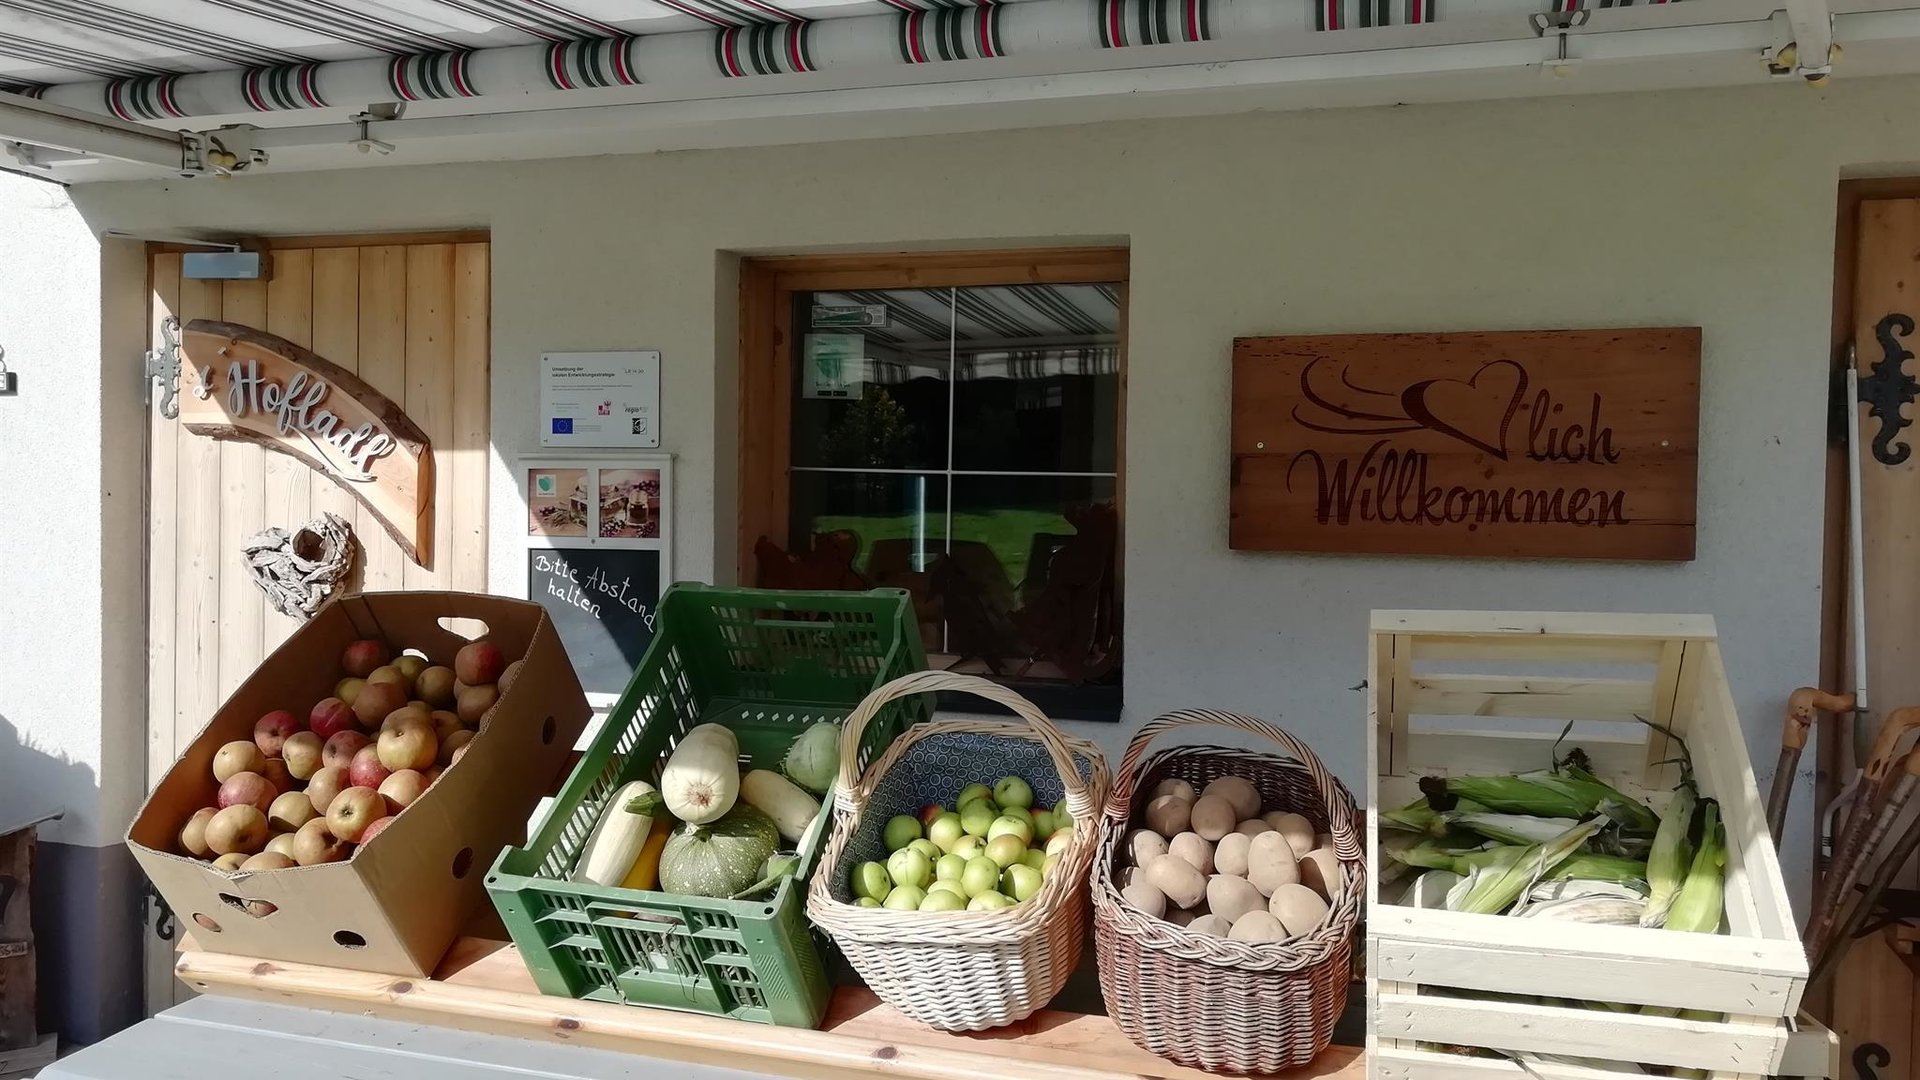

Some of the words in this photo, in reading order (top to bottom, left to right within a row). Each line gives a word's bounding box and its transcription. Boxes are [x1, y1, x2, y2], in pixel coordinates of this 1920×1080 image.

[1528, 388, 1620, 464] lich
[1286, 439, 1630, 528] Willkommen
[535, 555, 579, 584] Bitte
[584, 566, 657, 633] Abstand
[547, 578, 601, 619] halten
